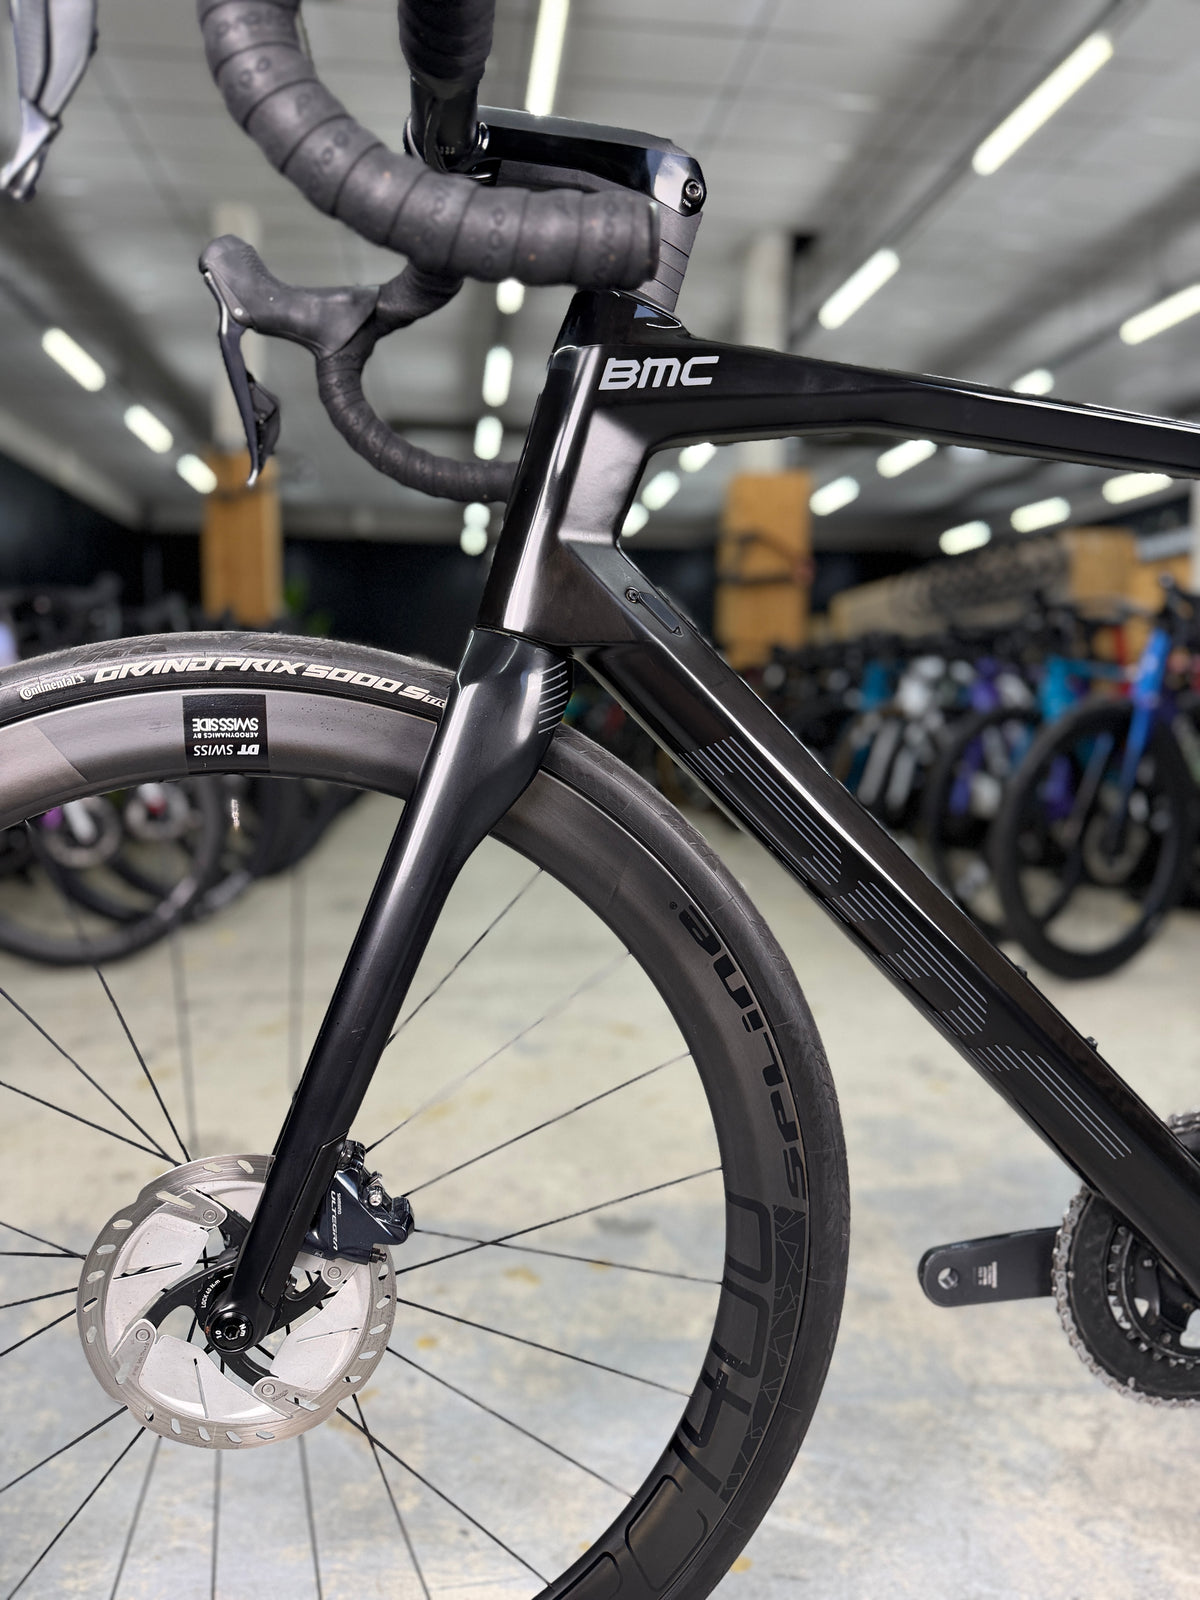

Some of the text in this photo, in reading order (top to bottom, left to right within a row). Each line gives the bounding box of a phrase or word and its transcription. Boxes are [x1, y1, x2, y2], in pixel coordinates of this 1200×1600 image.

[598, 355, 720, 391] BMC
[19, 675, 78, 701] Continental
[93, 657, 217, 684] GRAND
[214, 656, 306, 675] PRIX
[302, 663, 404, 693] 5000
[397, 685, 431, 700] S
[192, 717, 259, 732] SWISSSIDE
[193, 744, 260, 757] DT SWISS
[330, 1190, 339, 1251] ULTEGRA
[200, 1294, 209, 1309] LOCK
